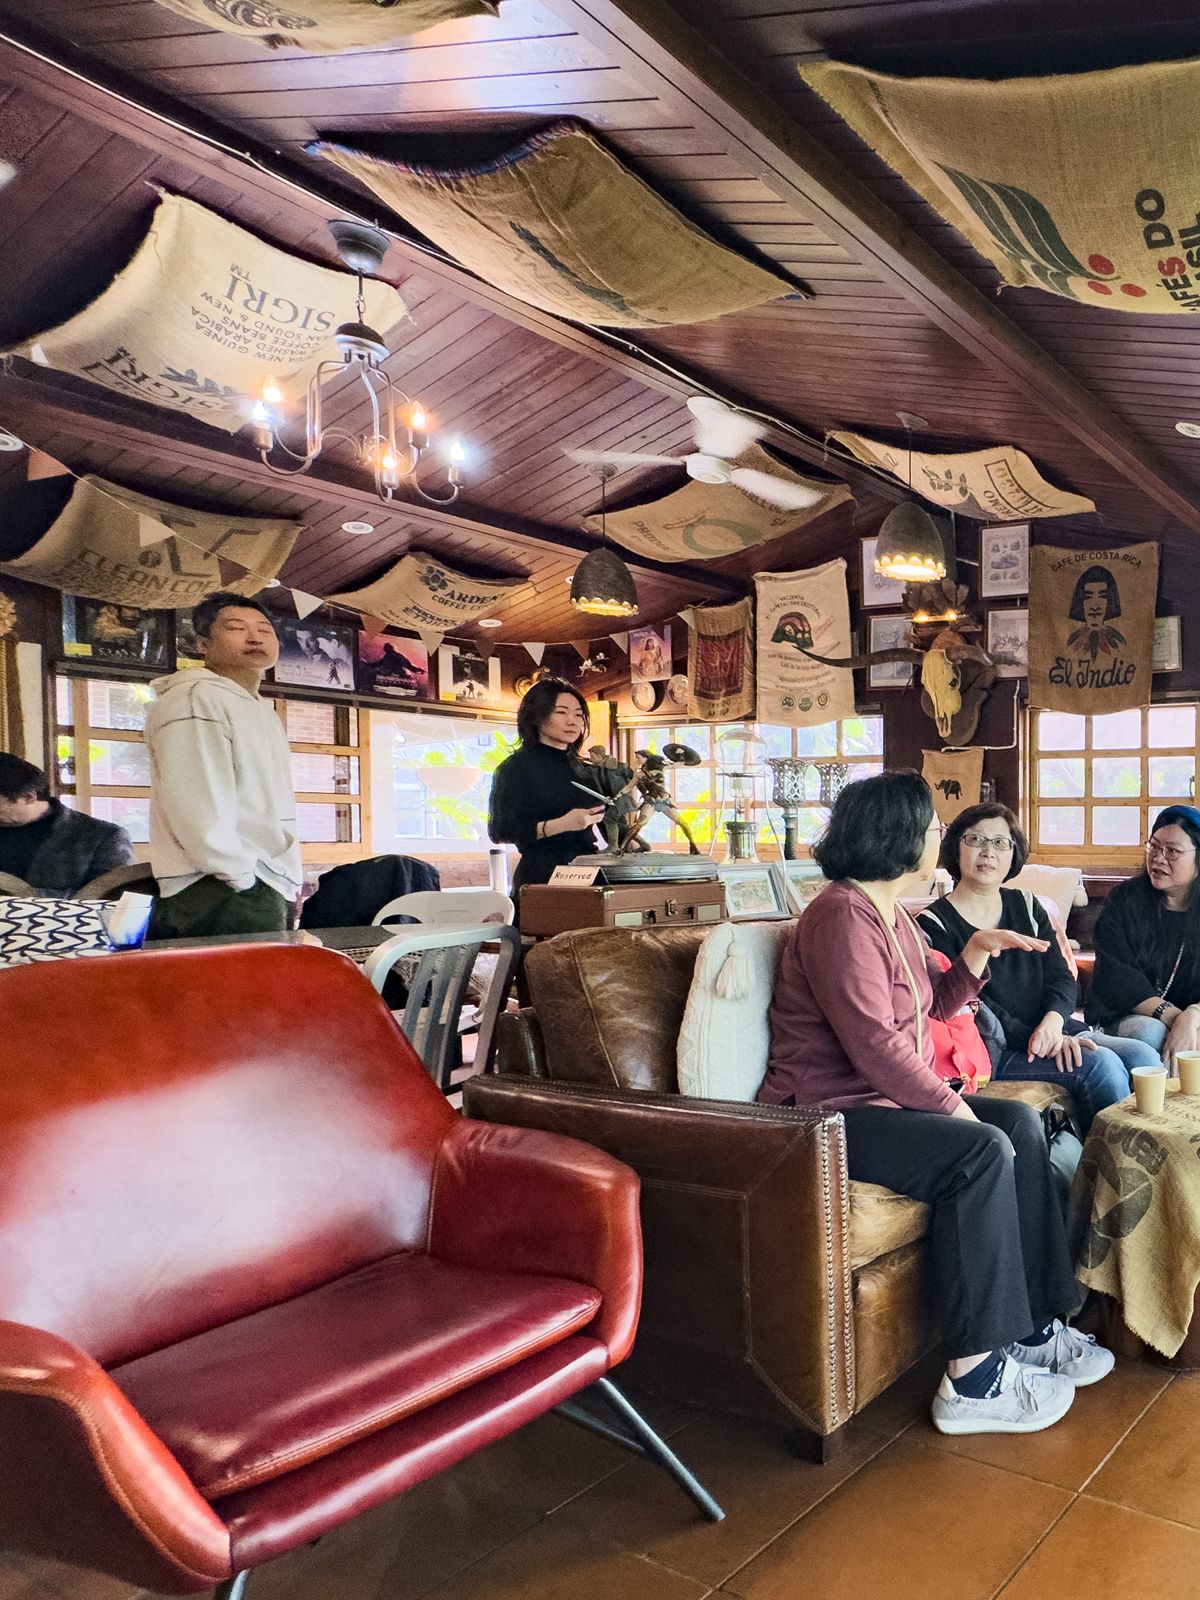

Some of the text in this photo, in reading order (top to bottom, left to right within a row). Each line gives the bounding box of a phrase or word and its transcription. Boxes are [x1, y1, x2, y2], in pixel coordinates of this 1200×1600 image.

[1135, 188, 1176, 250] DO
[200, 291, 233, 315] NEW
[224, 273, 336, 333] SIGRI
[190, 305, 308, 356] WASHED ARABICA
[194, 320, 249, 355] GUINEA
[221, 315, 321, 351] COFFEE BEANS
[254, 320, 303, 340] SOUND
[253, 351, 284, 363] NEW
[1051, 551, 1143, 572] CAFE DE COSTA RICA
[1049, 656, 1137, 689] El Indio
[553, 869, 593, 882] Reserved
